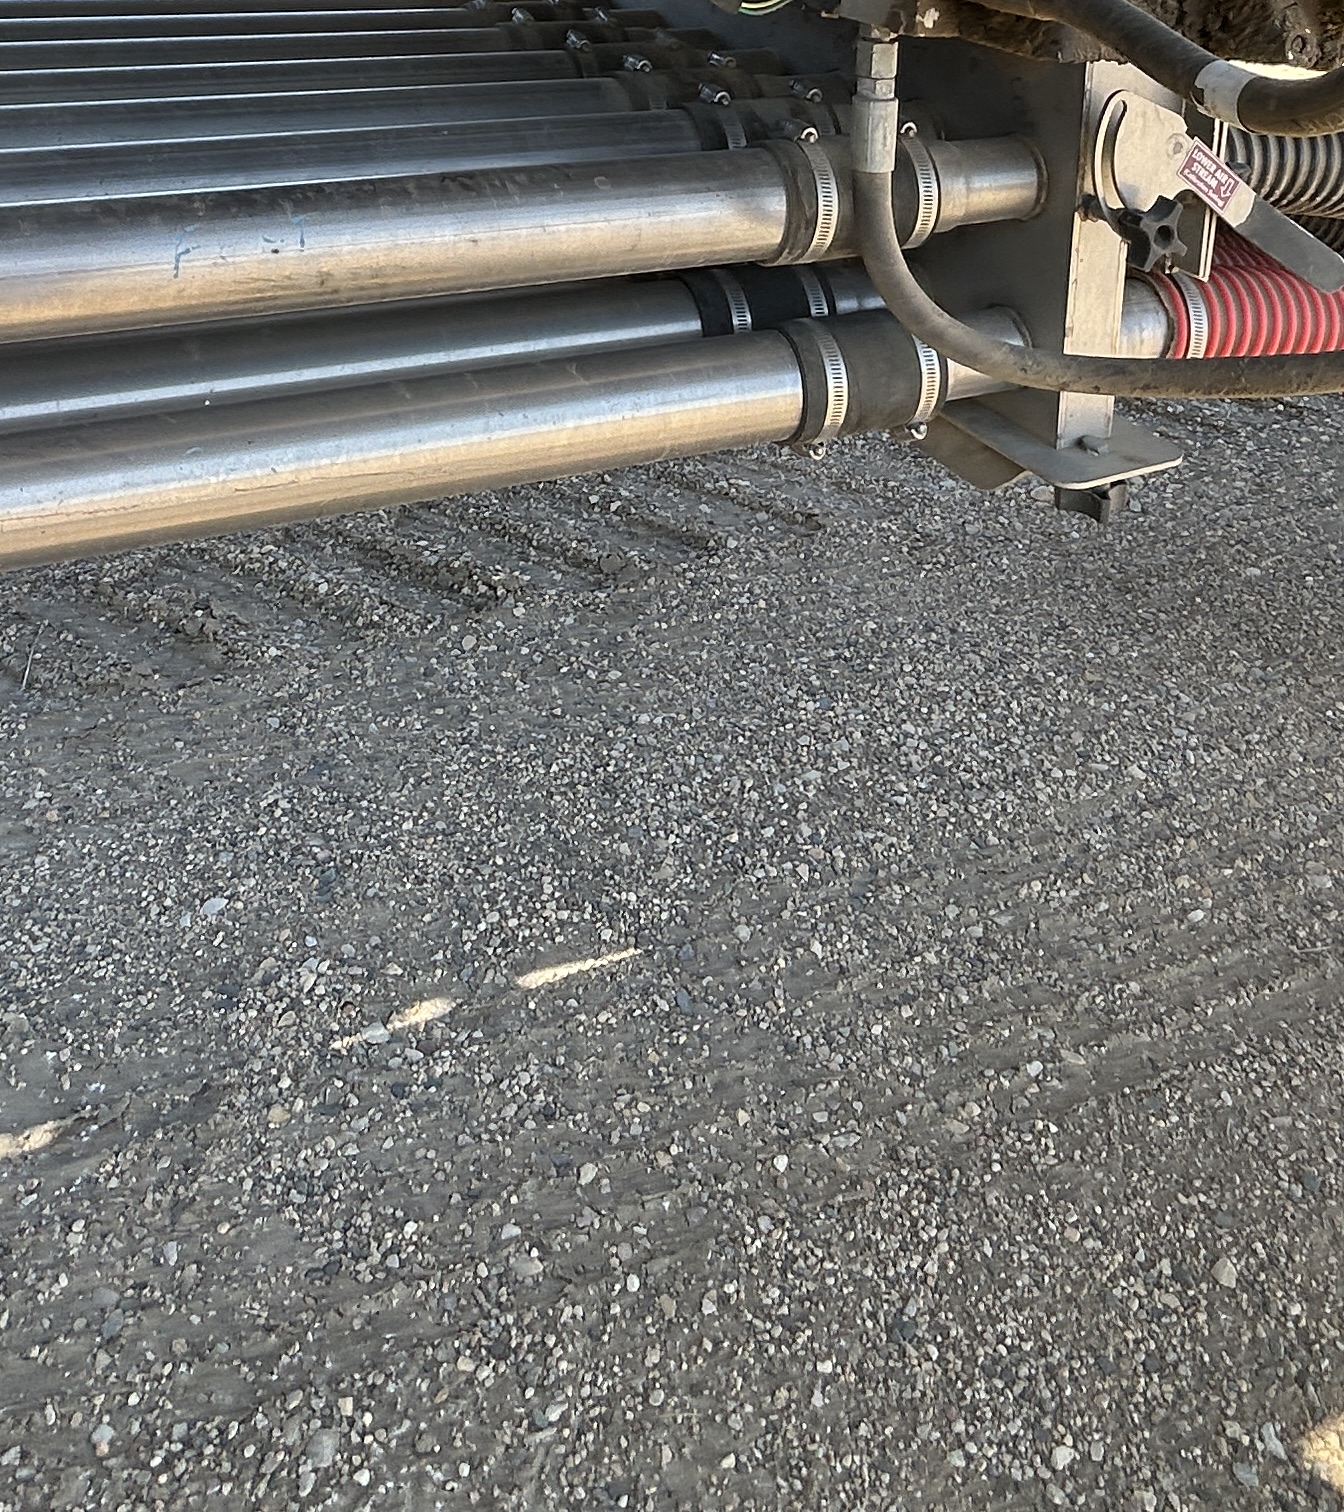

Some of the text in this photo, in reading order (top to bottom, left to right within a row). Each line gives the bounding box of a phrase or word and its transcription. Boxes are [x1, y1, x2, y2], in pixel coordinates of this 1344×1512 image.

[1191, 148, 1229, 185] LOWER AIR
[1191, 161, 1219, 190] STREAM
